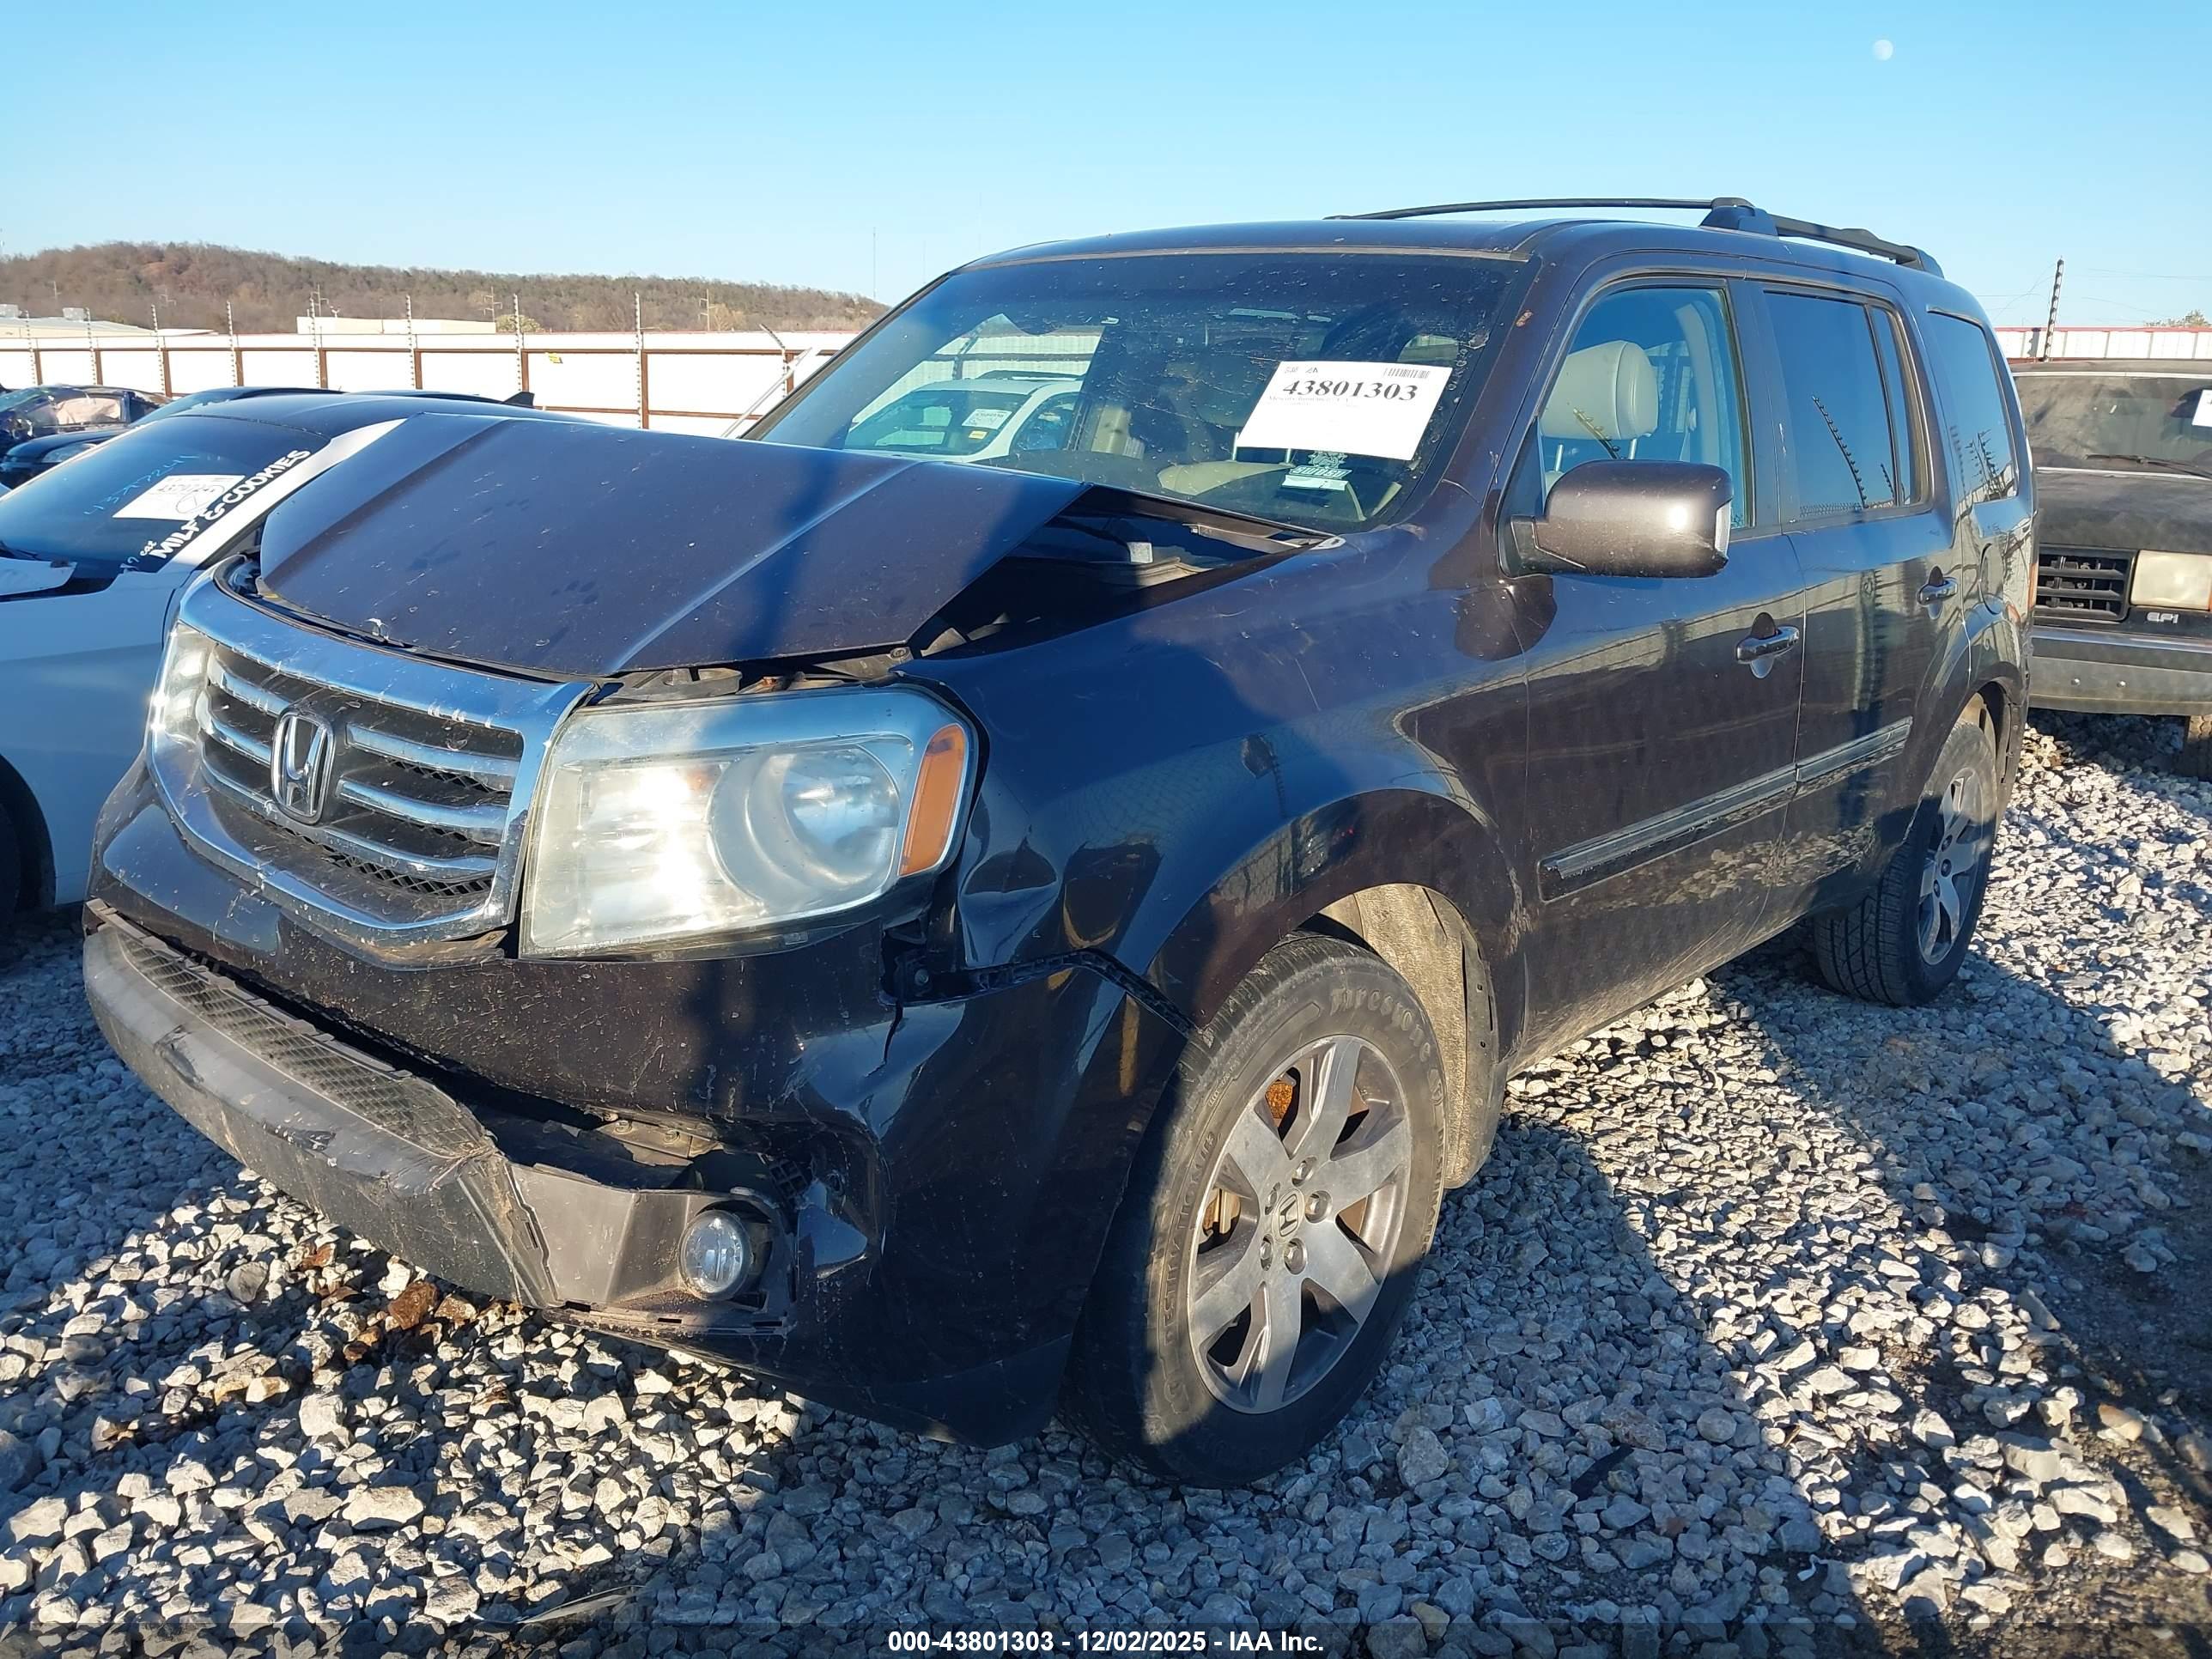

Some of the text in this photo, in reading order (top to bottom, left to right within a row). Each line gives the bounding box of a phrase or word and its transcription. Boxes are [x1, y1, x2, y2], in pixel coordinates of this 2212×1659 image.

[1282, 380, 1419, 401] 43801303
[149, 449, 312, 559] MILF & COOKIES
[1330, 987, 1431, 1063] Firestone
